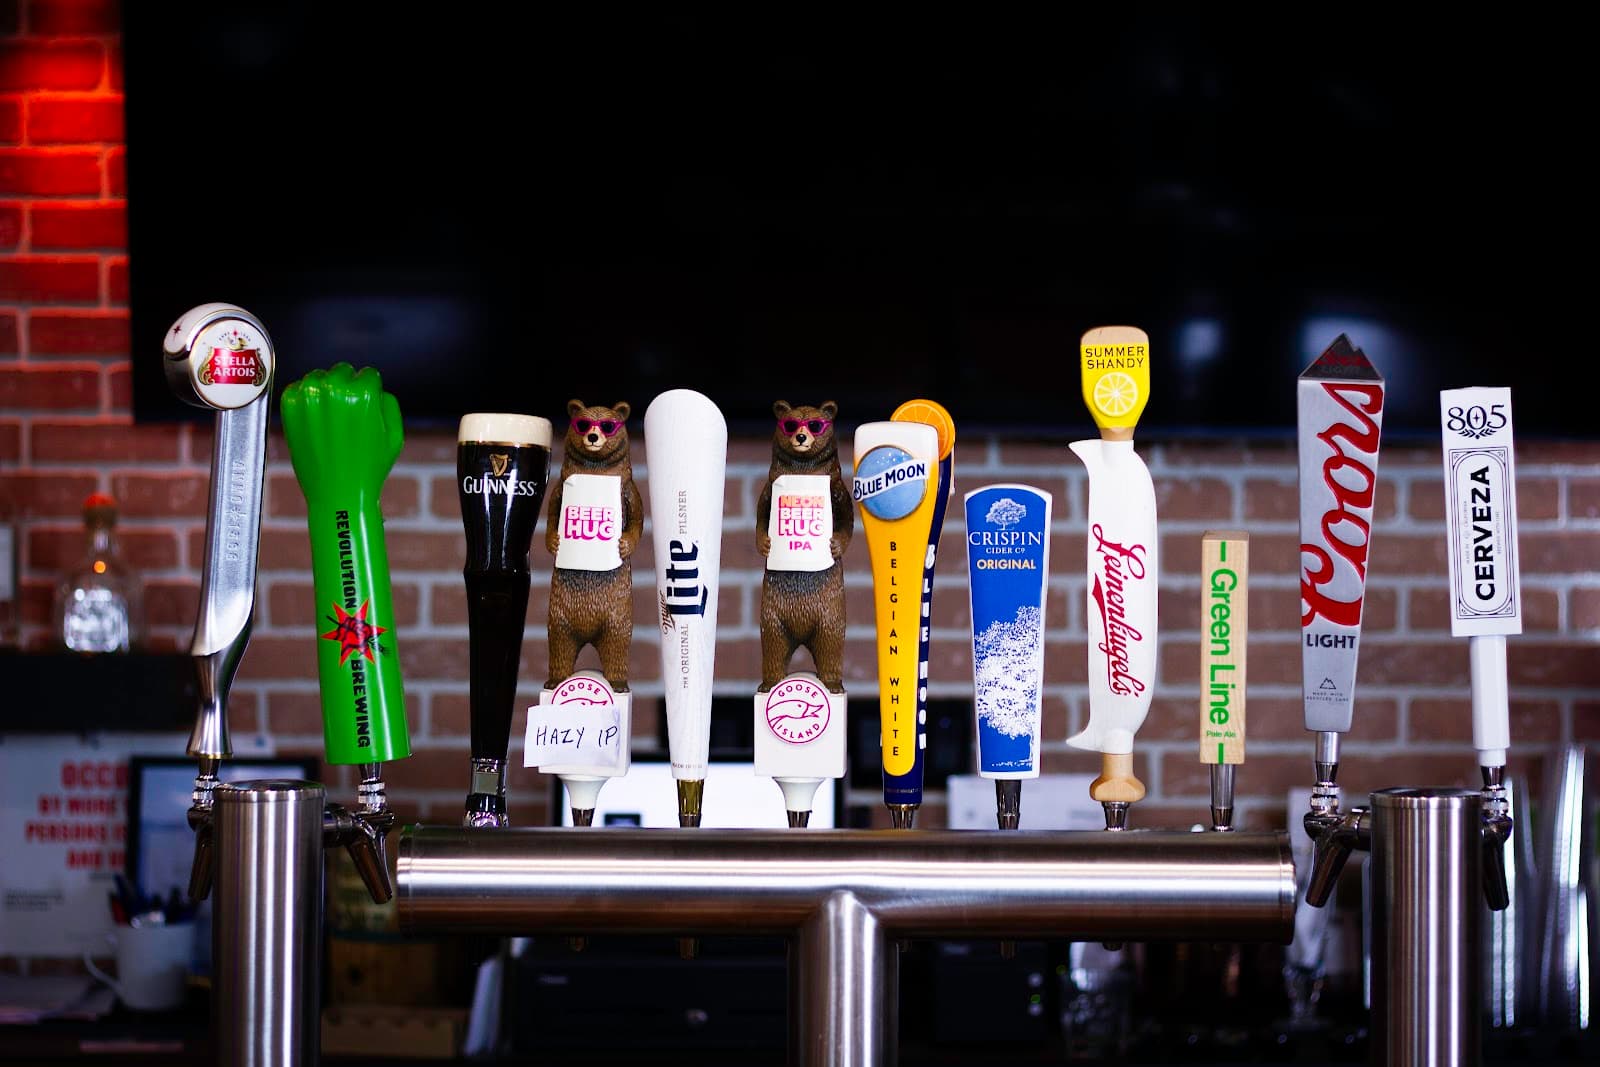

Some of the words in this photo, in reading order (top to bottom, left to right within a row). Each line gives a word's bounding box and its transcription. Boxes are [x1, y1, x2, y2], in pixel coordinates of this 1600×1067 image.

[213, 356, 256, 366] STELLA
[1085, 346, 1145, 358] SUMMER
[213, 367, 256, 377] ARTOIS
[1087, 358, 1144, 370] SHANDY
[1447, 404, 1507, 433] 805
[463, 475, 537, 497] GUINNESS
[853, 478, 883, 499] BLUE
[885, 463, 926, 488] MOON
[779, 495, 825, 508] NEON
[564, 506, 615, 521] BEER
[678, 490, 688, 535] PILSNER
[779, 507, 825, 520] BEER
[564, 519, 615, 541] HUG
[779, 519, 825, 537] HUG
[1470, 465, 1496, 601] CERVEZA
[789, 540, 812, 551] IPA
[969, 531, 1042, 546] CRISPIN
[335, 510, 358, 609] REVOLUTION
[976, 558, 1037, 570] ORIGINAL
[666, 540, 708, 618] Lite
[889, 541, 898, 655] BELGIAN
[1210, 568, 1238, 656] Green
[680, 623, 689, 674] ORIGINAL
[1305, 633, 1357, 649] LIGHT
[561, 682, 601, 697] GOOSE
[778, 684, 819, 698] GOOSE
[1209, 664, 1236, 725] Line
[350, 659, 371, 748] BREWING
[889, 678, 900, 756] WHITE
[536, 725, 585, 749] HAZY
[598, 725, 620, 748] IP
[776, 723, 820, 739] ISLAND
[1206, 730, 1222, 738] Pale
[1224, 730, 1236, 738] Ale
